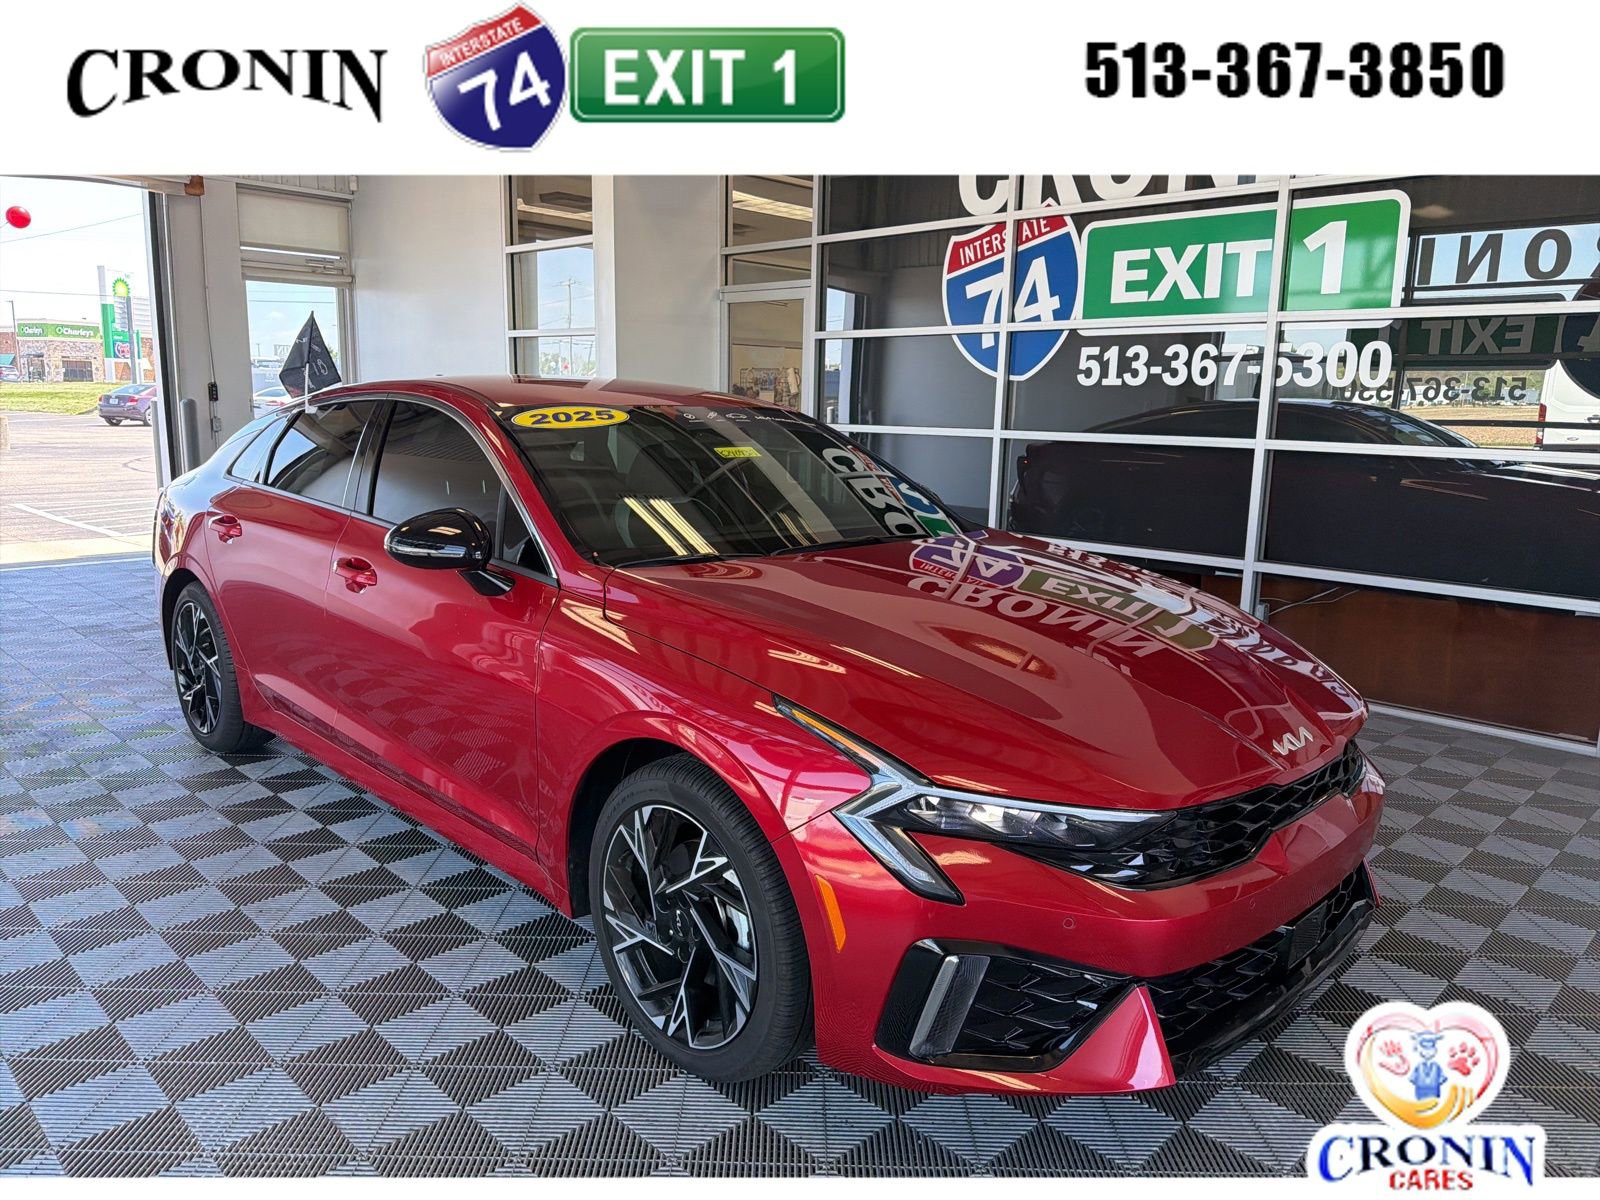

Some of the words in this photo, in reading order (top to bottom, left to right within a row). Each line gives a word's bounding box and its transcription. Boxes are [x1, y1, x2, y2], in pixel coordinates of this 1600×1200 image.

[1110, 238, 1274, 304] EXIT
[1302, 219, 1348, 296] 1
[965, 255, 1061, 350] 74
[1076, 340, 1394, 388] 513-367-5300
[529, 408, 616, 426] 2025
